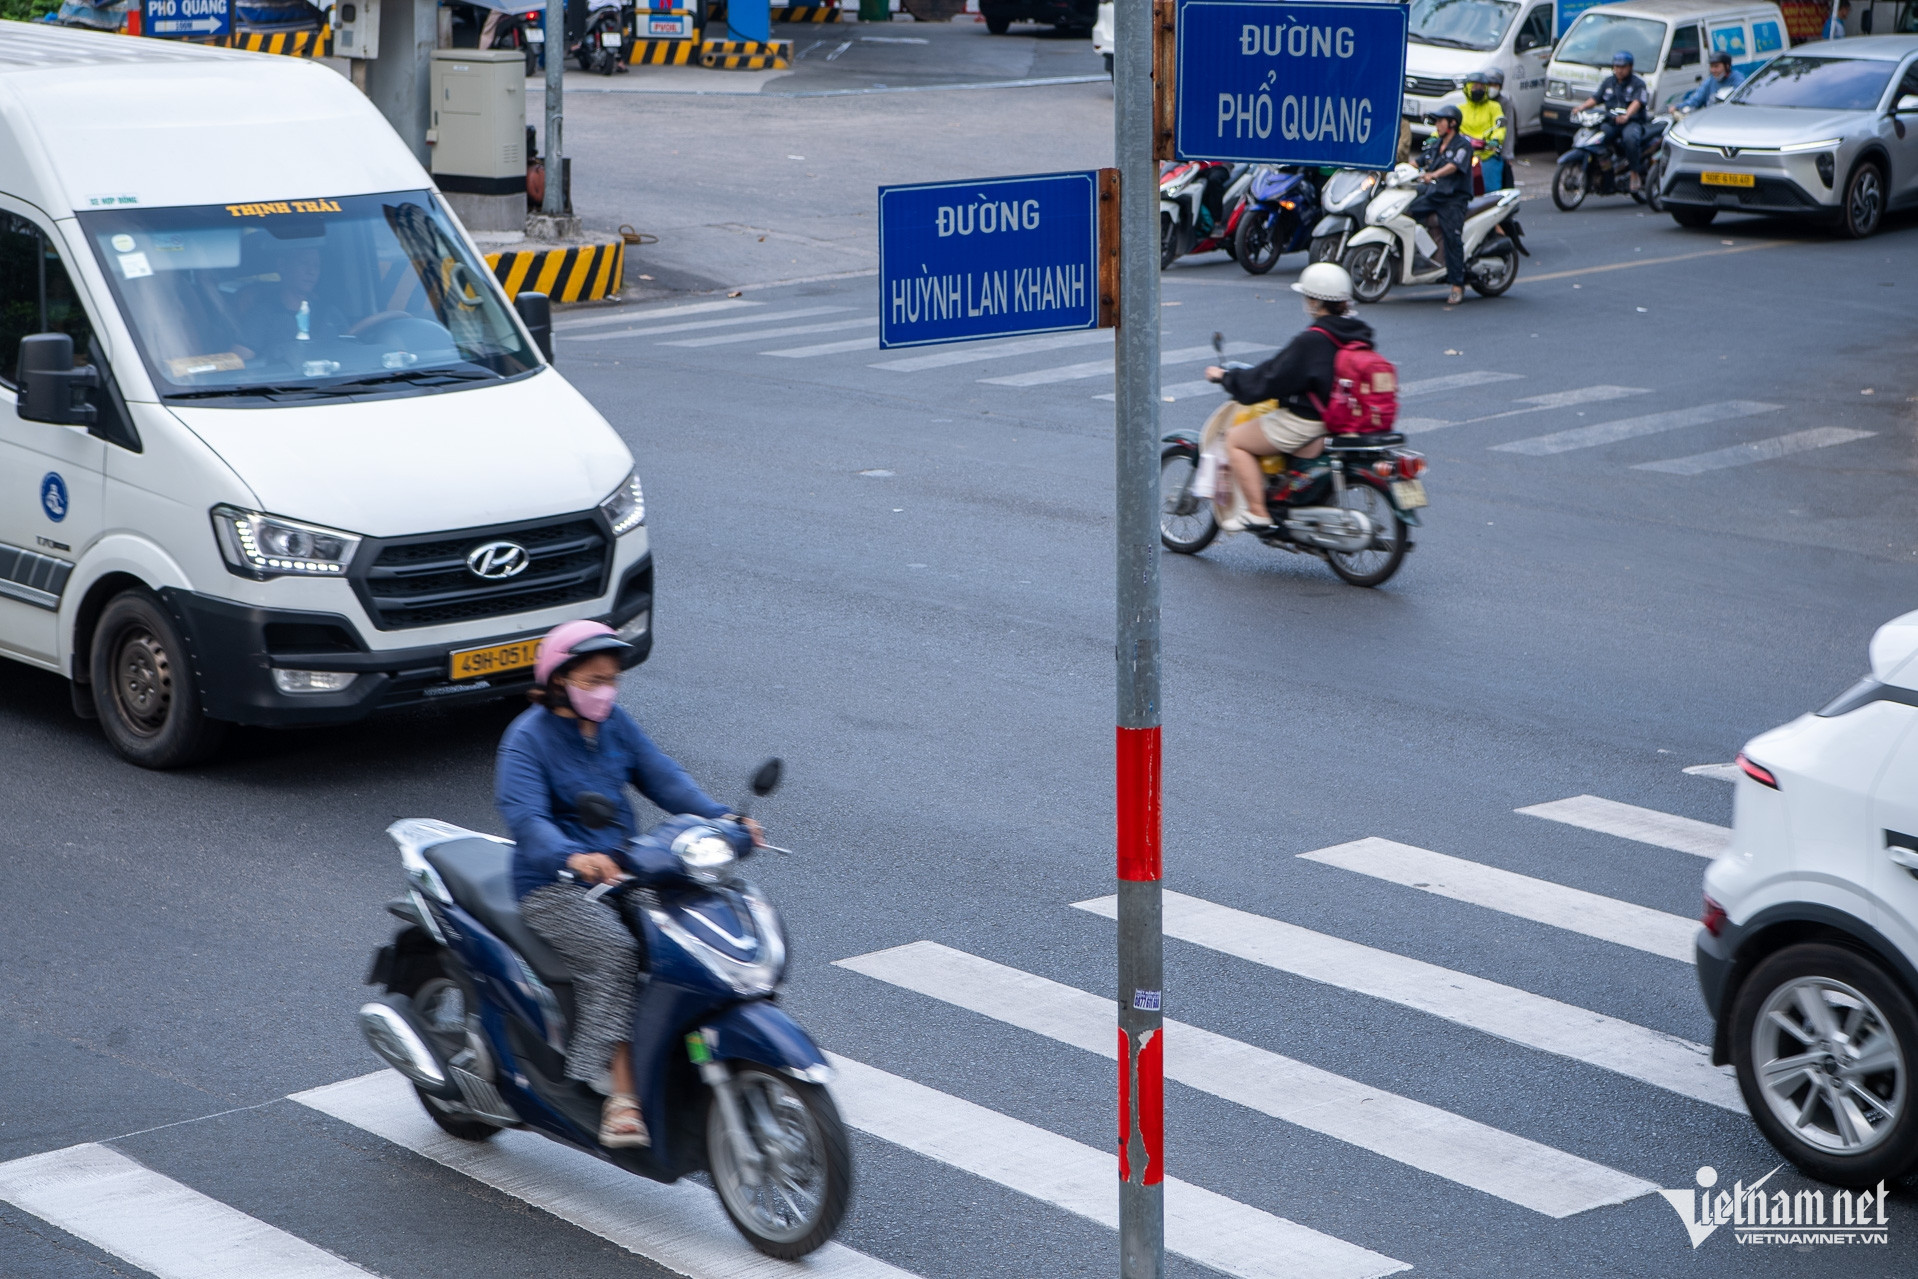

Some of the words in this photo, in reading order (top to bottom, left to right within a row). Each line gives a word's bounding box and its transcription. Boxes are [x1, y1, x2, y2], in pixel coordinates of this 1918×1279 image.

[181, 0, 228, 18] QUANG
[1239, 15, 1355, 59] ĐƯỜNG
[1217, 69, 1277, 140] PHỔ
[1281, 94, 1373, 145] QUANG
[225, 202, 292, 217] THỊNH
[290, 198, 342, 213] THÁI
[935, 193, 1040, 238] ĐƯỜNG
[892, 263, 962, 325] HUỲNH
[967, 269, 1008, 318] LAN
[1014, 263, 1085, 313] KHANH
